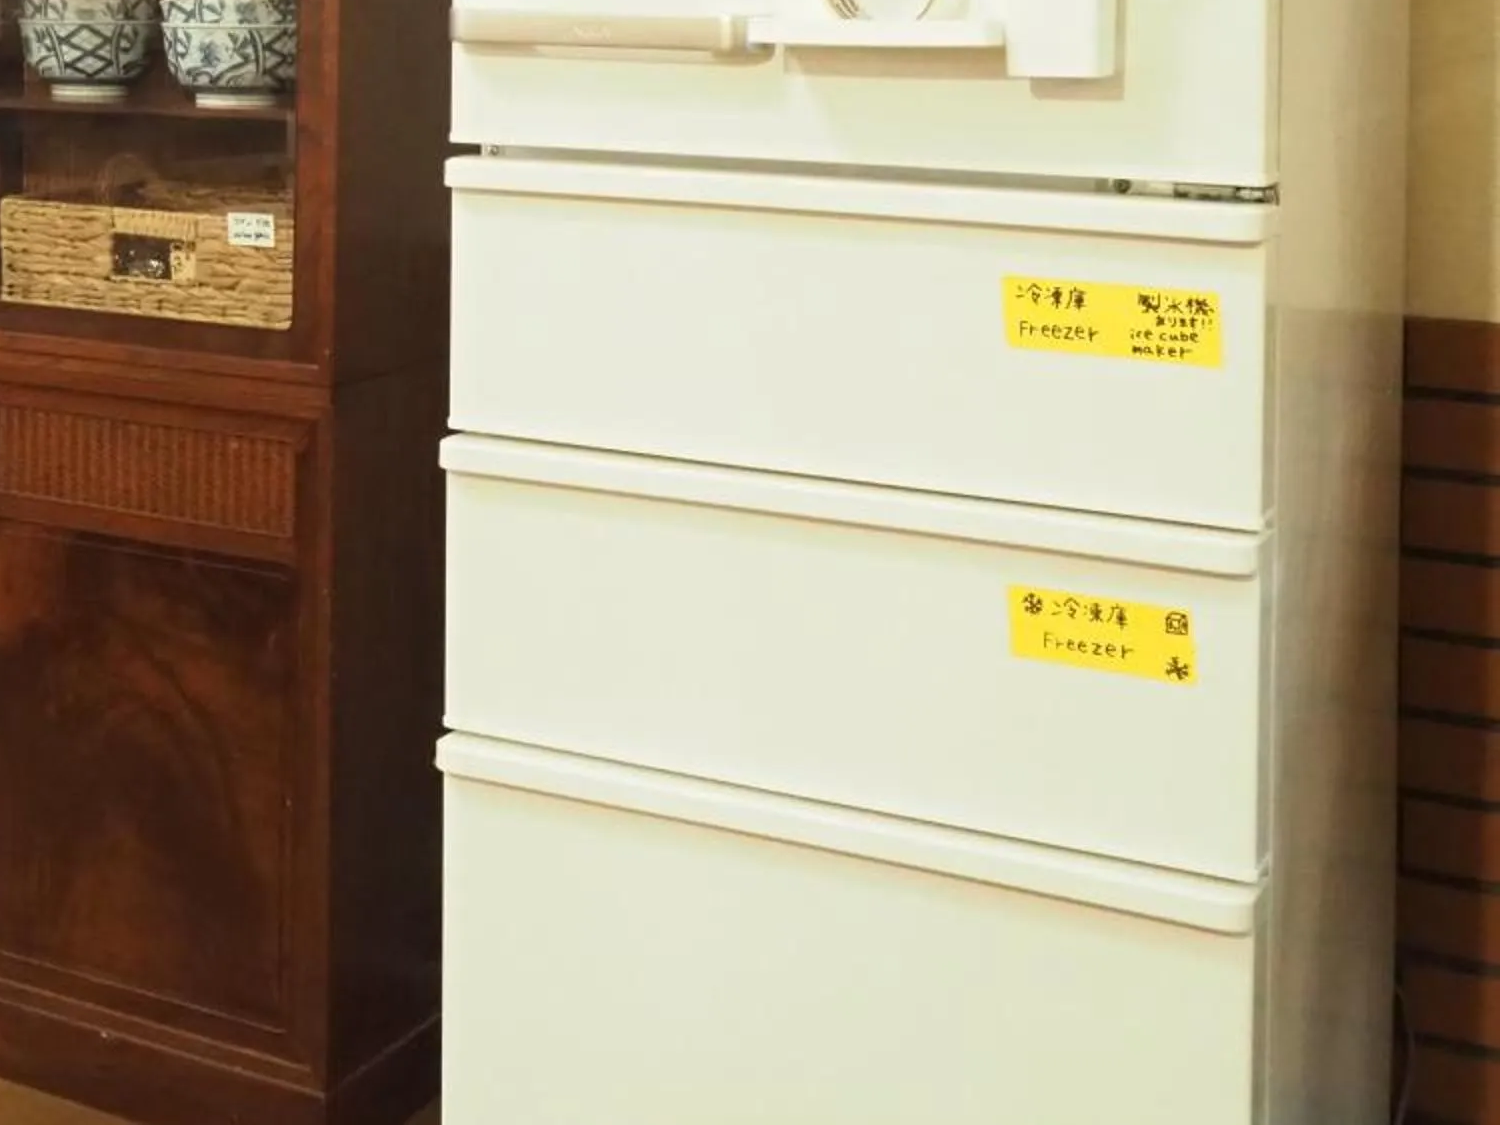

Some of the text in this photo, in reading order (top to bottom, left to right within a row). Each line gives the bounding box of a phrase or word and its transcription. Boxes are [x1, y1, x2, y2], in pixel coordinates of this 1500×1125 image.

[1014, 282, 1087, 311] 冷凍庫
[1018, 319, 1100, 343] Freezer
[1129, 328, 1200, 344] ice cube
[1131, 343, 1194, 360] maker
[1050, 596, 1129, 631] 冷凍庫
[1043, 630, 1135, 660] Freezer
